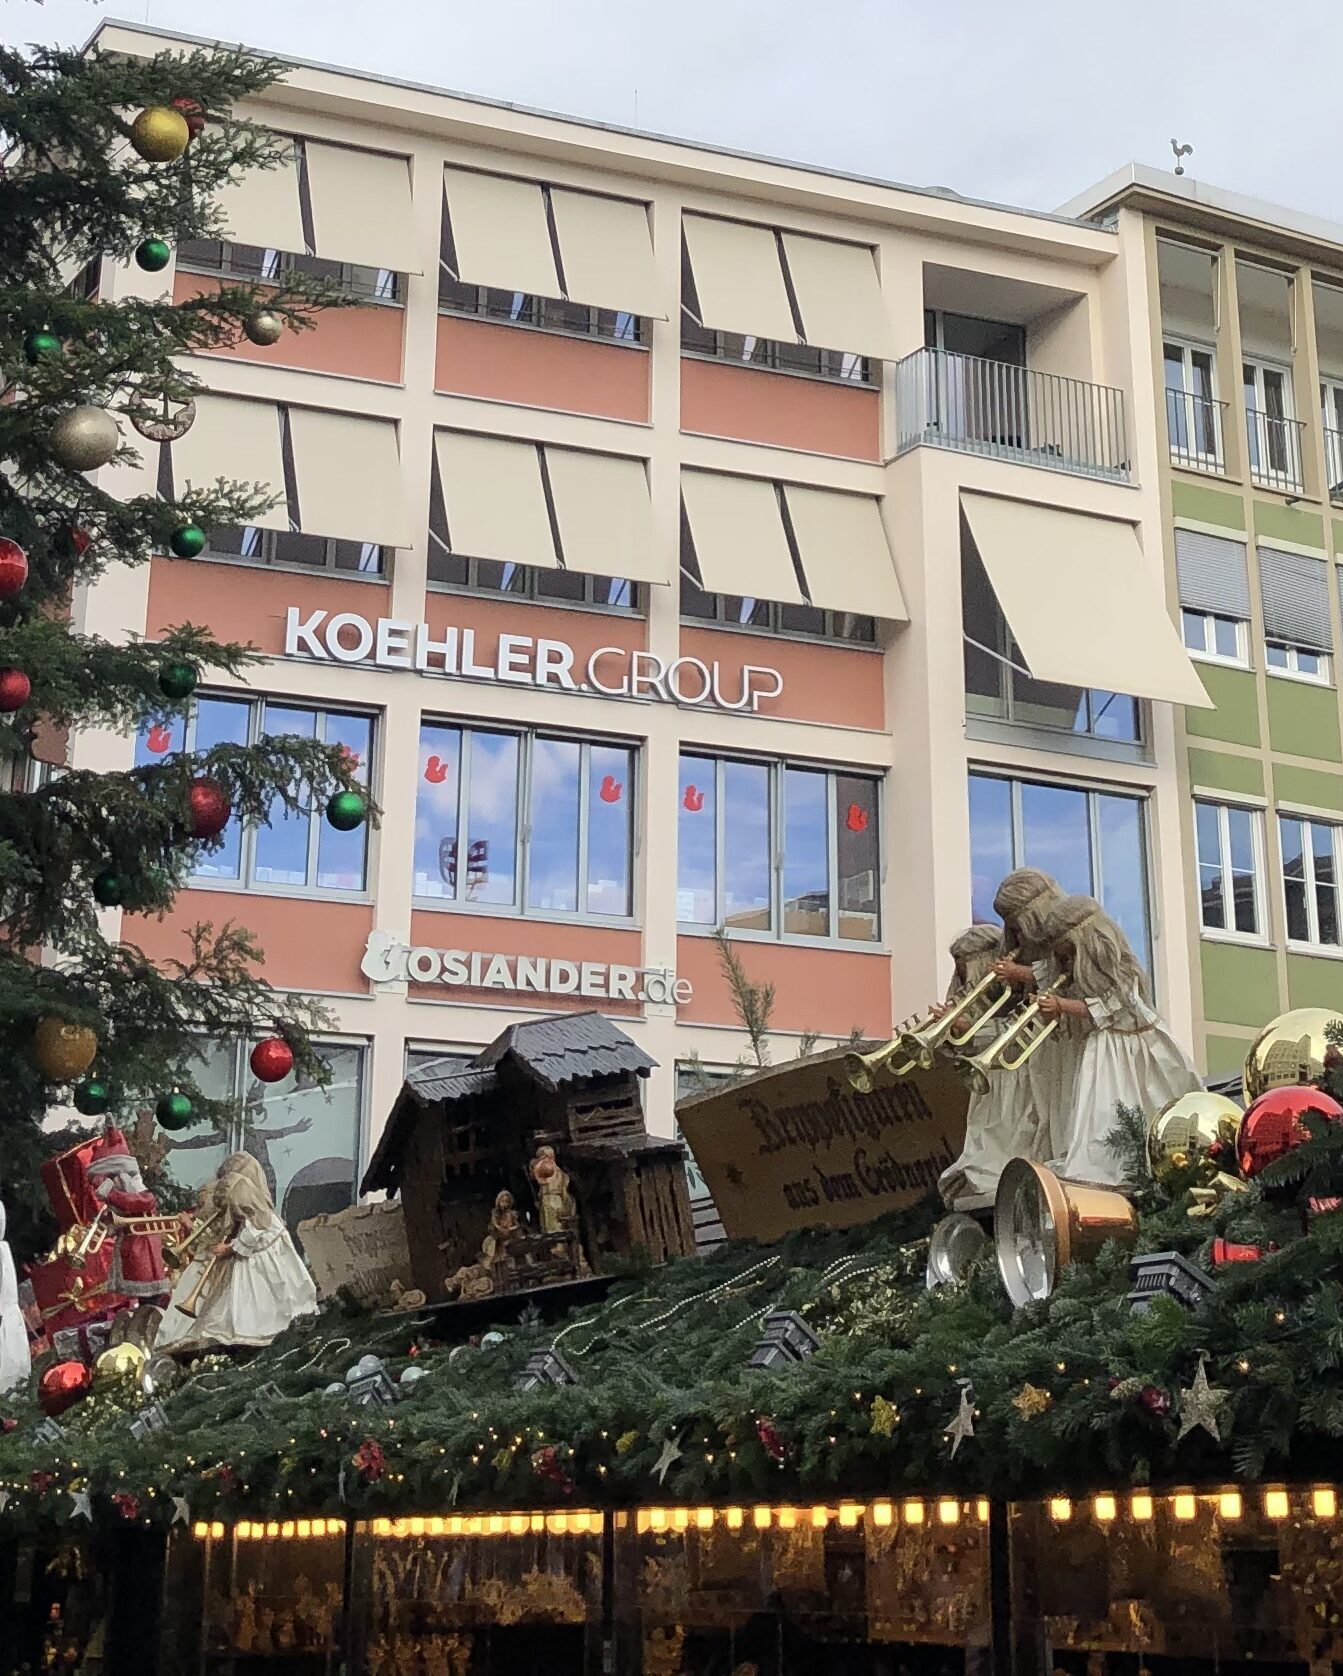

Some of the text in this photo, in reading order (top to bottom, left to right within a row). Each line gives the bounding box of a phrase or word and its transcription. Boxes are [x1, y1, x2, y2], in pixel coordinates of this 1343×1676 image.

[407, 946, 693, 1005] OSIANDER.de
[783, 1178, 819, 1210] aus
[813, 1164, 862, 1203] dem
